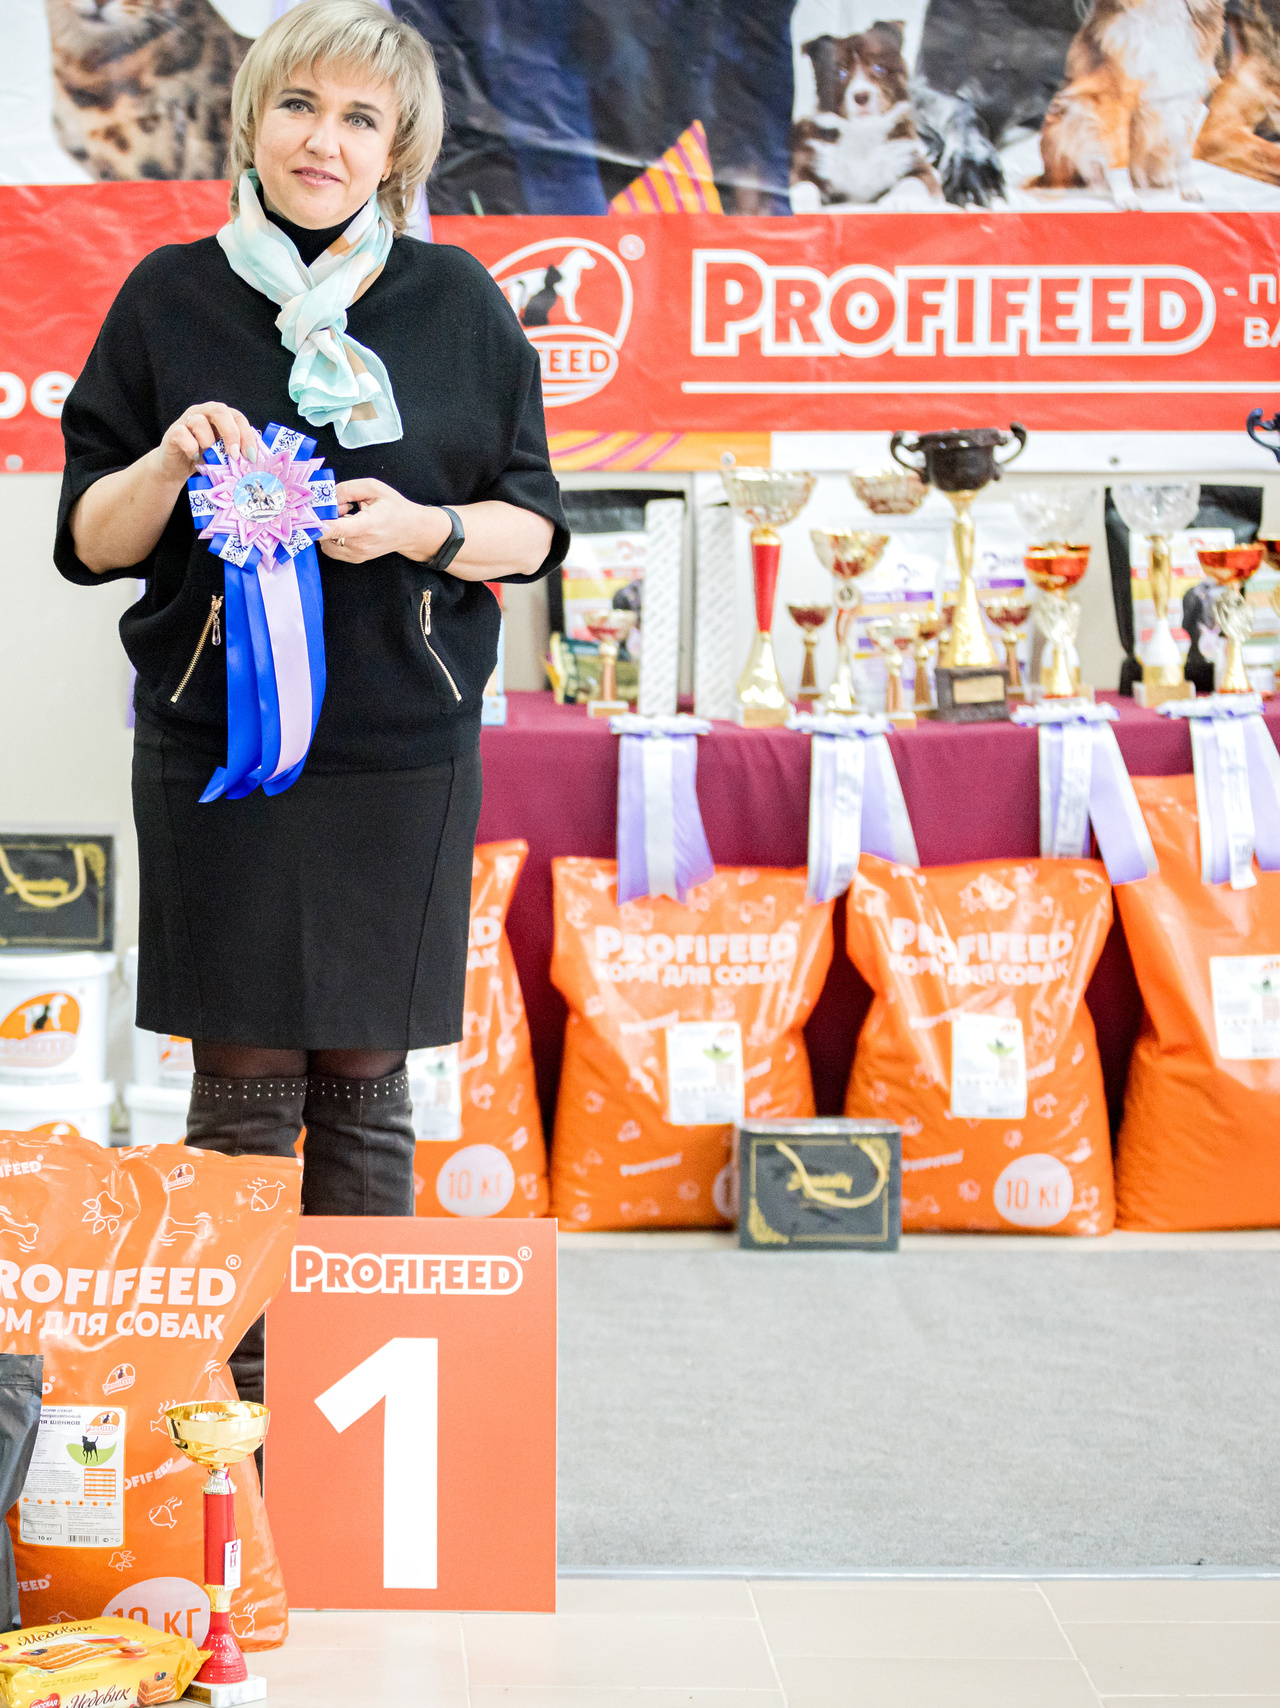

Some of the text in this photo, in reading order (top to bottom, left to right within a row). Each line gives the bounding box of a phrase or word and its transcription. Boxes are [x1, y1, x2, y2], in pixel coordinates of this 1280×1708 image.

[692, 248, 1216, 357] PROFIFEED
[595, 925, 798, 964] PROFIFEED
[662, 964, 711, 987] ДЛЯ
[449, 1169, 472, 1200] 10
[1005, 1178, 1030, 1210] 10
[291, 1244, 524, 1296] PROFIFEED
[39, 1310, 108, 1340] ДЛЯ
[115, 1311, 226, 1340] СОБАК
[313, 1337, 439, 1590] 1
[17, 1625, 93, 1647] Медовик
[65, 1684, 132, 1708] Медовик
